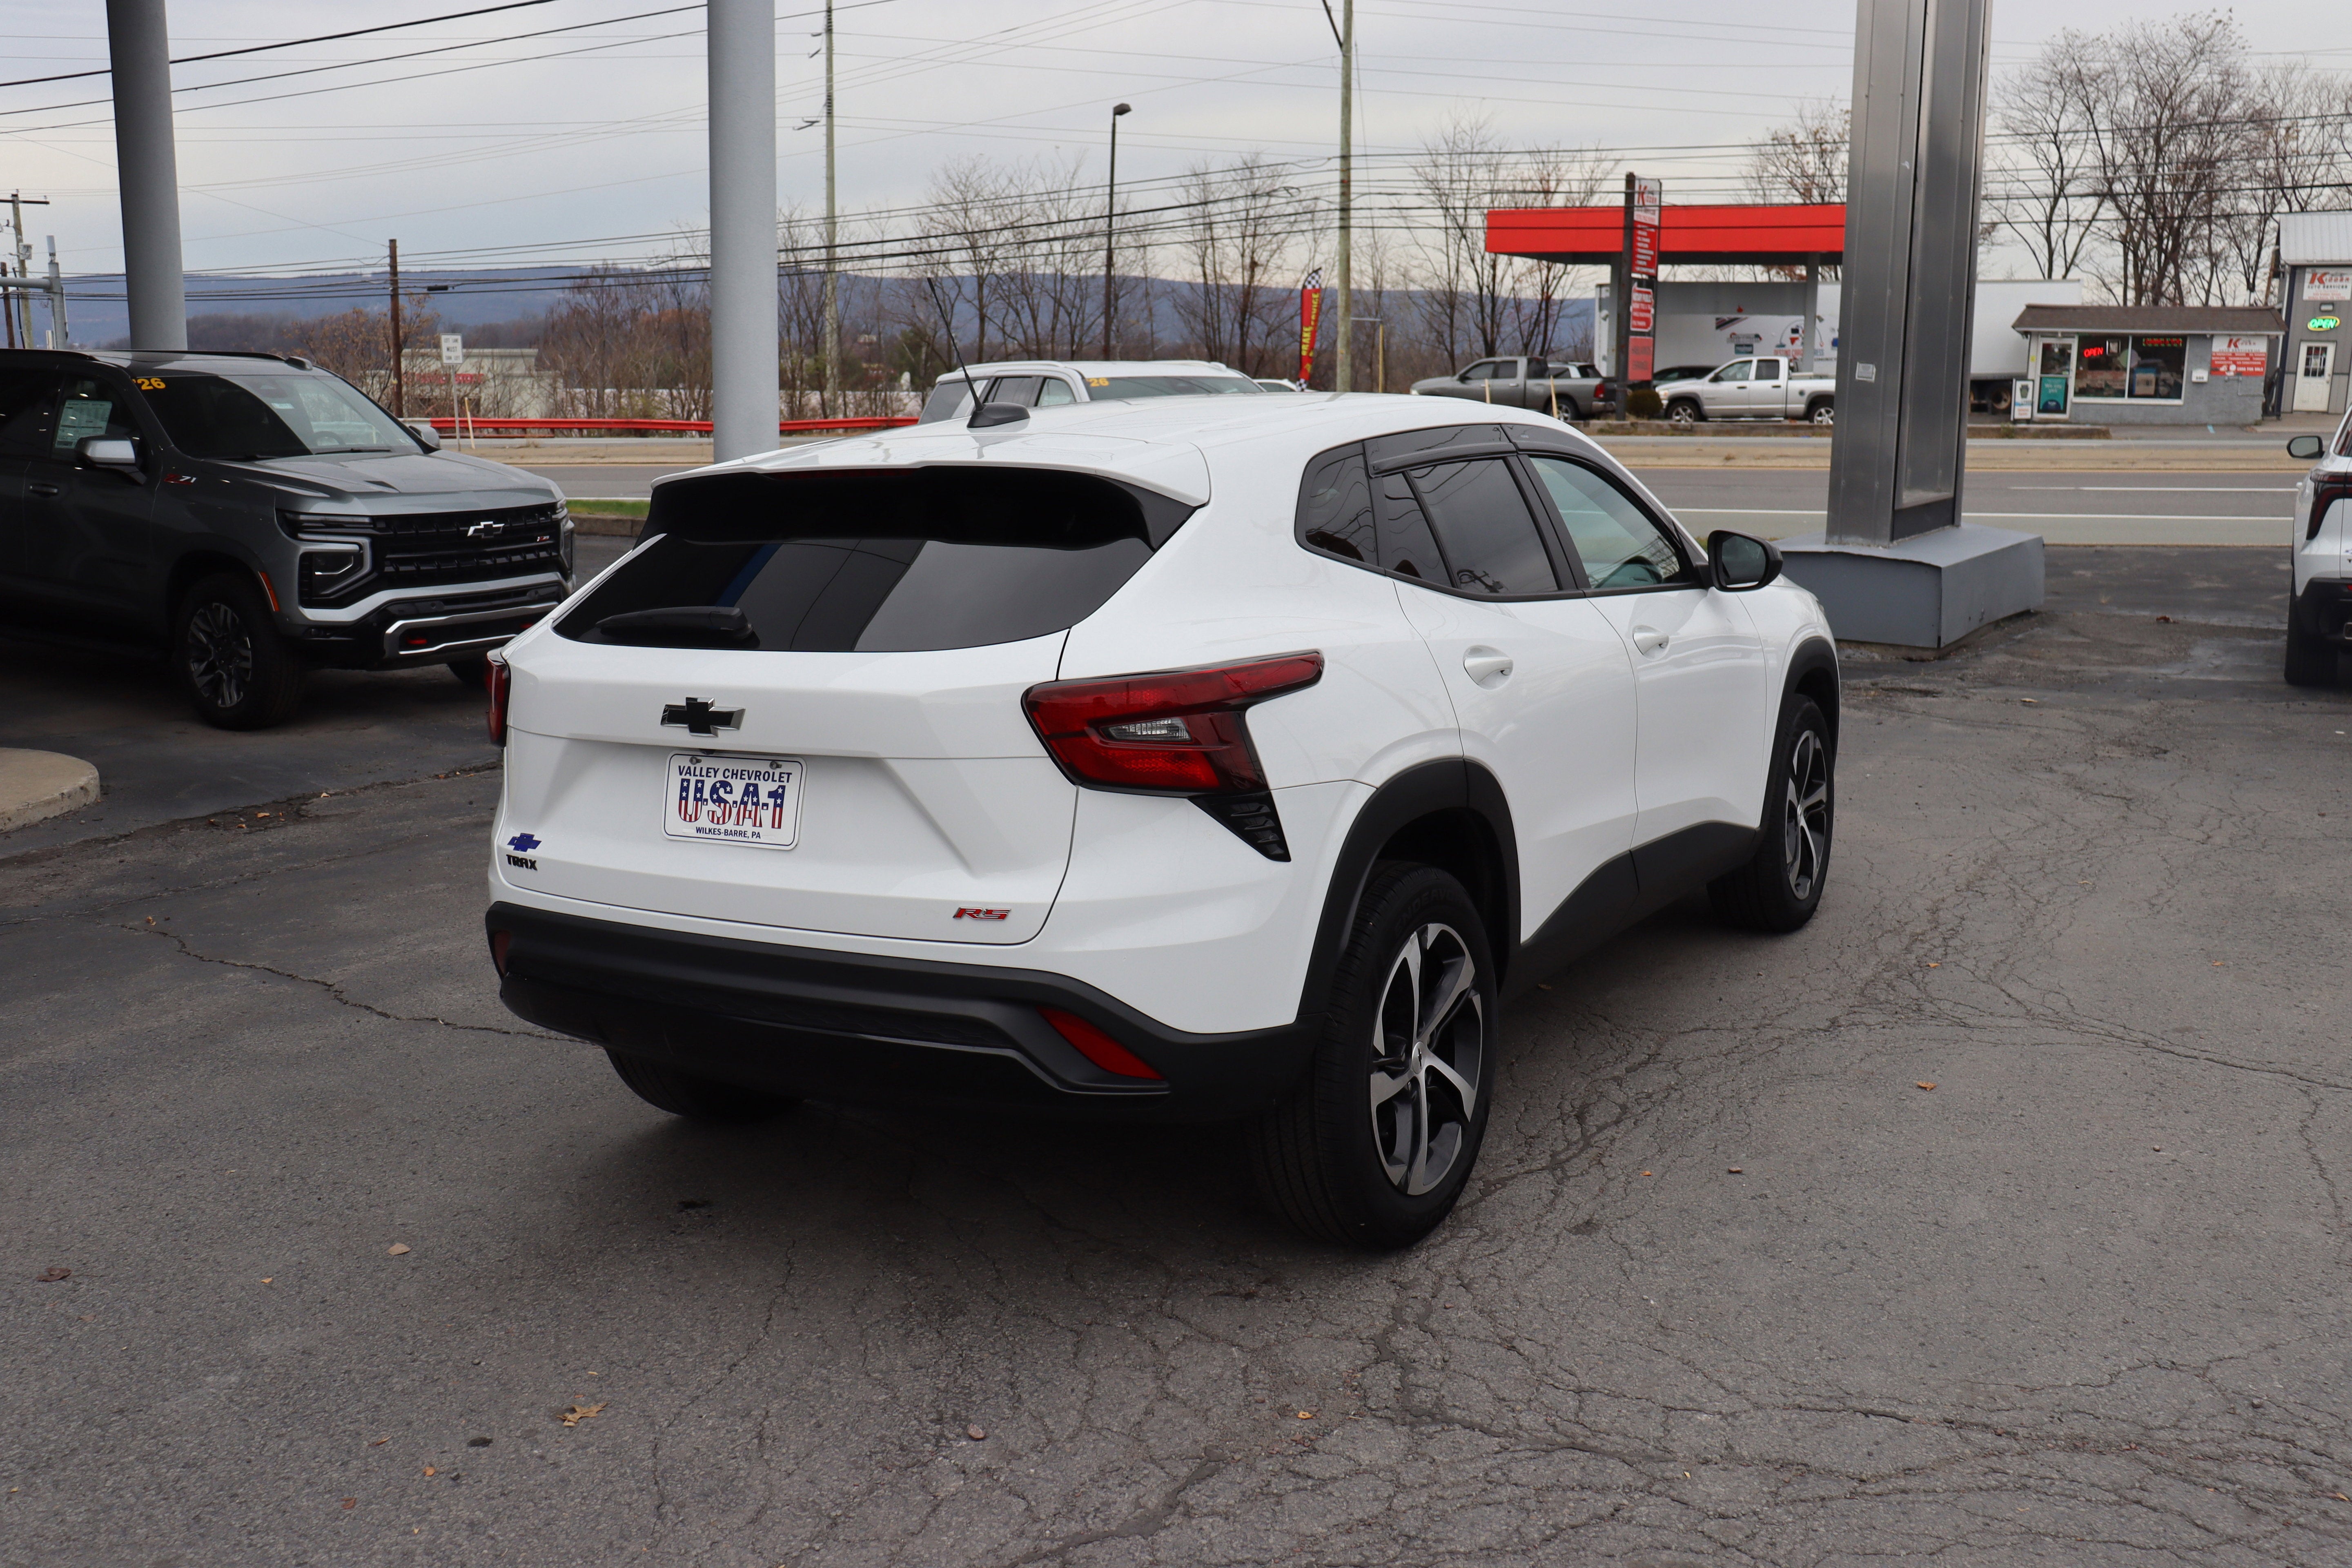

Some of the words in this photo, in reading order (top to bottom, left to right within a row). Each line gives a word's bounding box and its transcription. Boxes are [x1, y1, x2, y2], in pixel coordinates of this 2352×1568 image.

[2310, 318, 2336, 328] OPEN
[1301, 326, 1312, 356] BRAKE
[2083, 347, 2104, 357] OPEN
[678, 765, 719, 777] VALLEY
[722, 768, 792, 783] CHEVROLET
[695, 826, 749, 839] WILKES-BARRE,
[506, 854, 538, 871] TRAX
[953, 907, 1011, 920] RS
